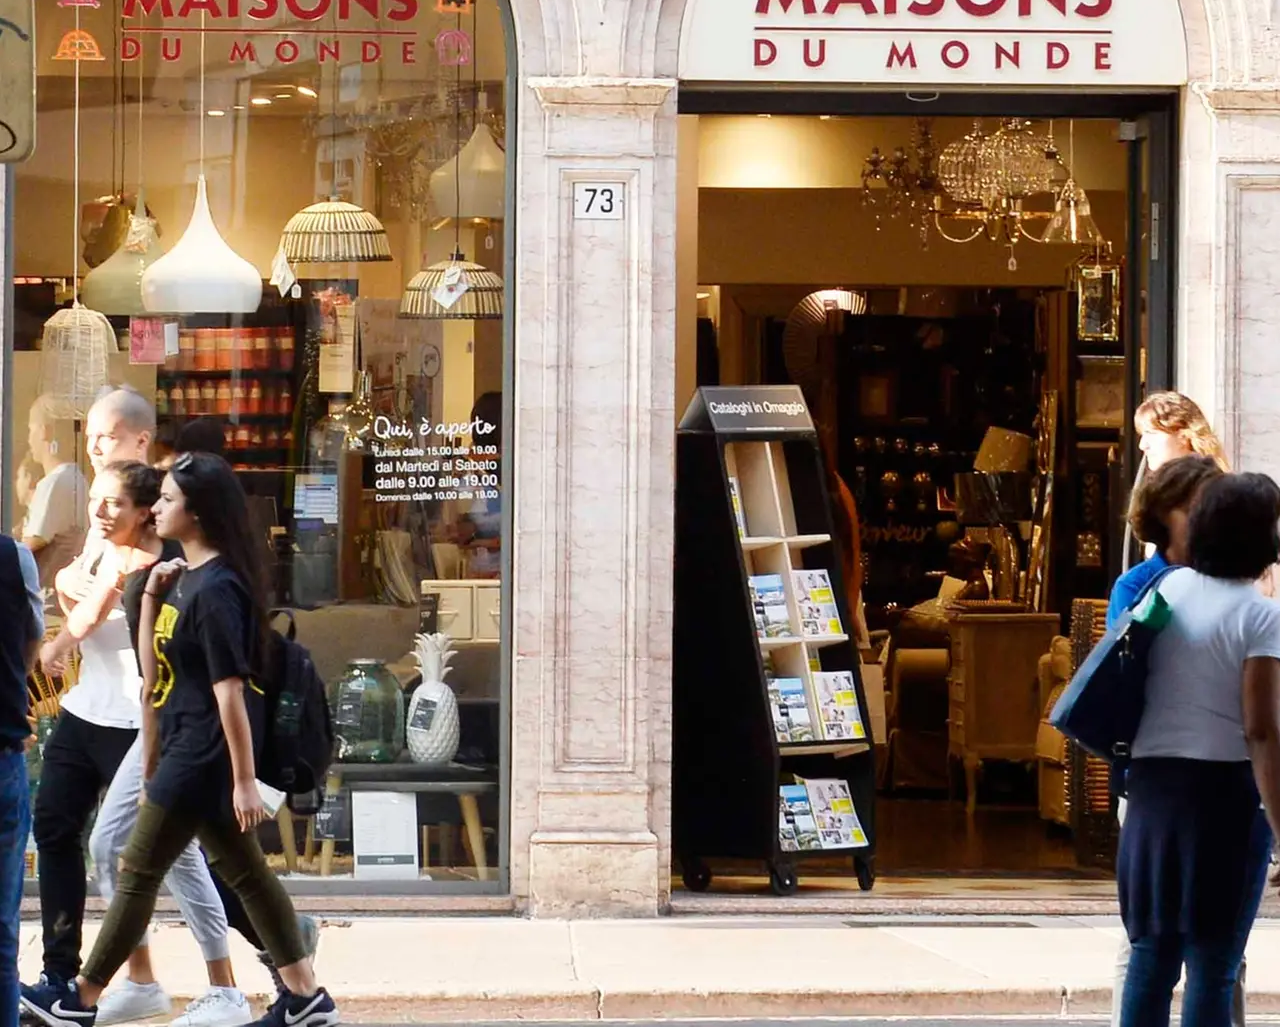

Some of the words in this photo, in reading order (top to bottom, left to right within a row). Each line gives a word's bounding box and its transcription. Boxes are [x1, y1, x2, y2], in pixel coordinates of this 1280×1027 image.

[121, 37, 181, 62] DU
[229, 40, 416, 64] MONDE
[754, 38, 826, 68] DU
[885, 40, 1112, 71] MONDE
[584, 188, 614, 213] 73
[709, 401, 753, 416] Cataloghi
[762, 400, 805, 416] Omaggio
[374, 415, 414, 439] Qui,
[435, 415, 497, 442] aperto
[472, 445, 497, 455] 19.00
[375, 461, 393, 473] dal
[395, 460, 440, 473] Martedì
[442, 459, 453, 472] al
[455, 458, 498, 471] Sabato
[375, 476, 405, 489] dalle
[408, 475, 436, 488] 9.00
[438, 475, 460, 488] alle
[463, 474, 498, 487] 19.00
[375, 493, 411, 503] Domenica
